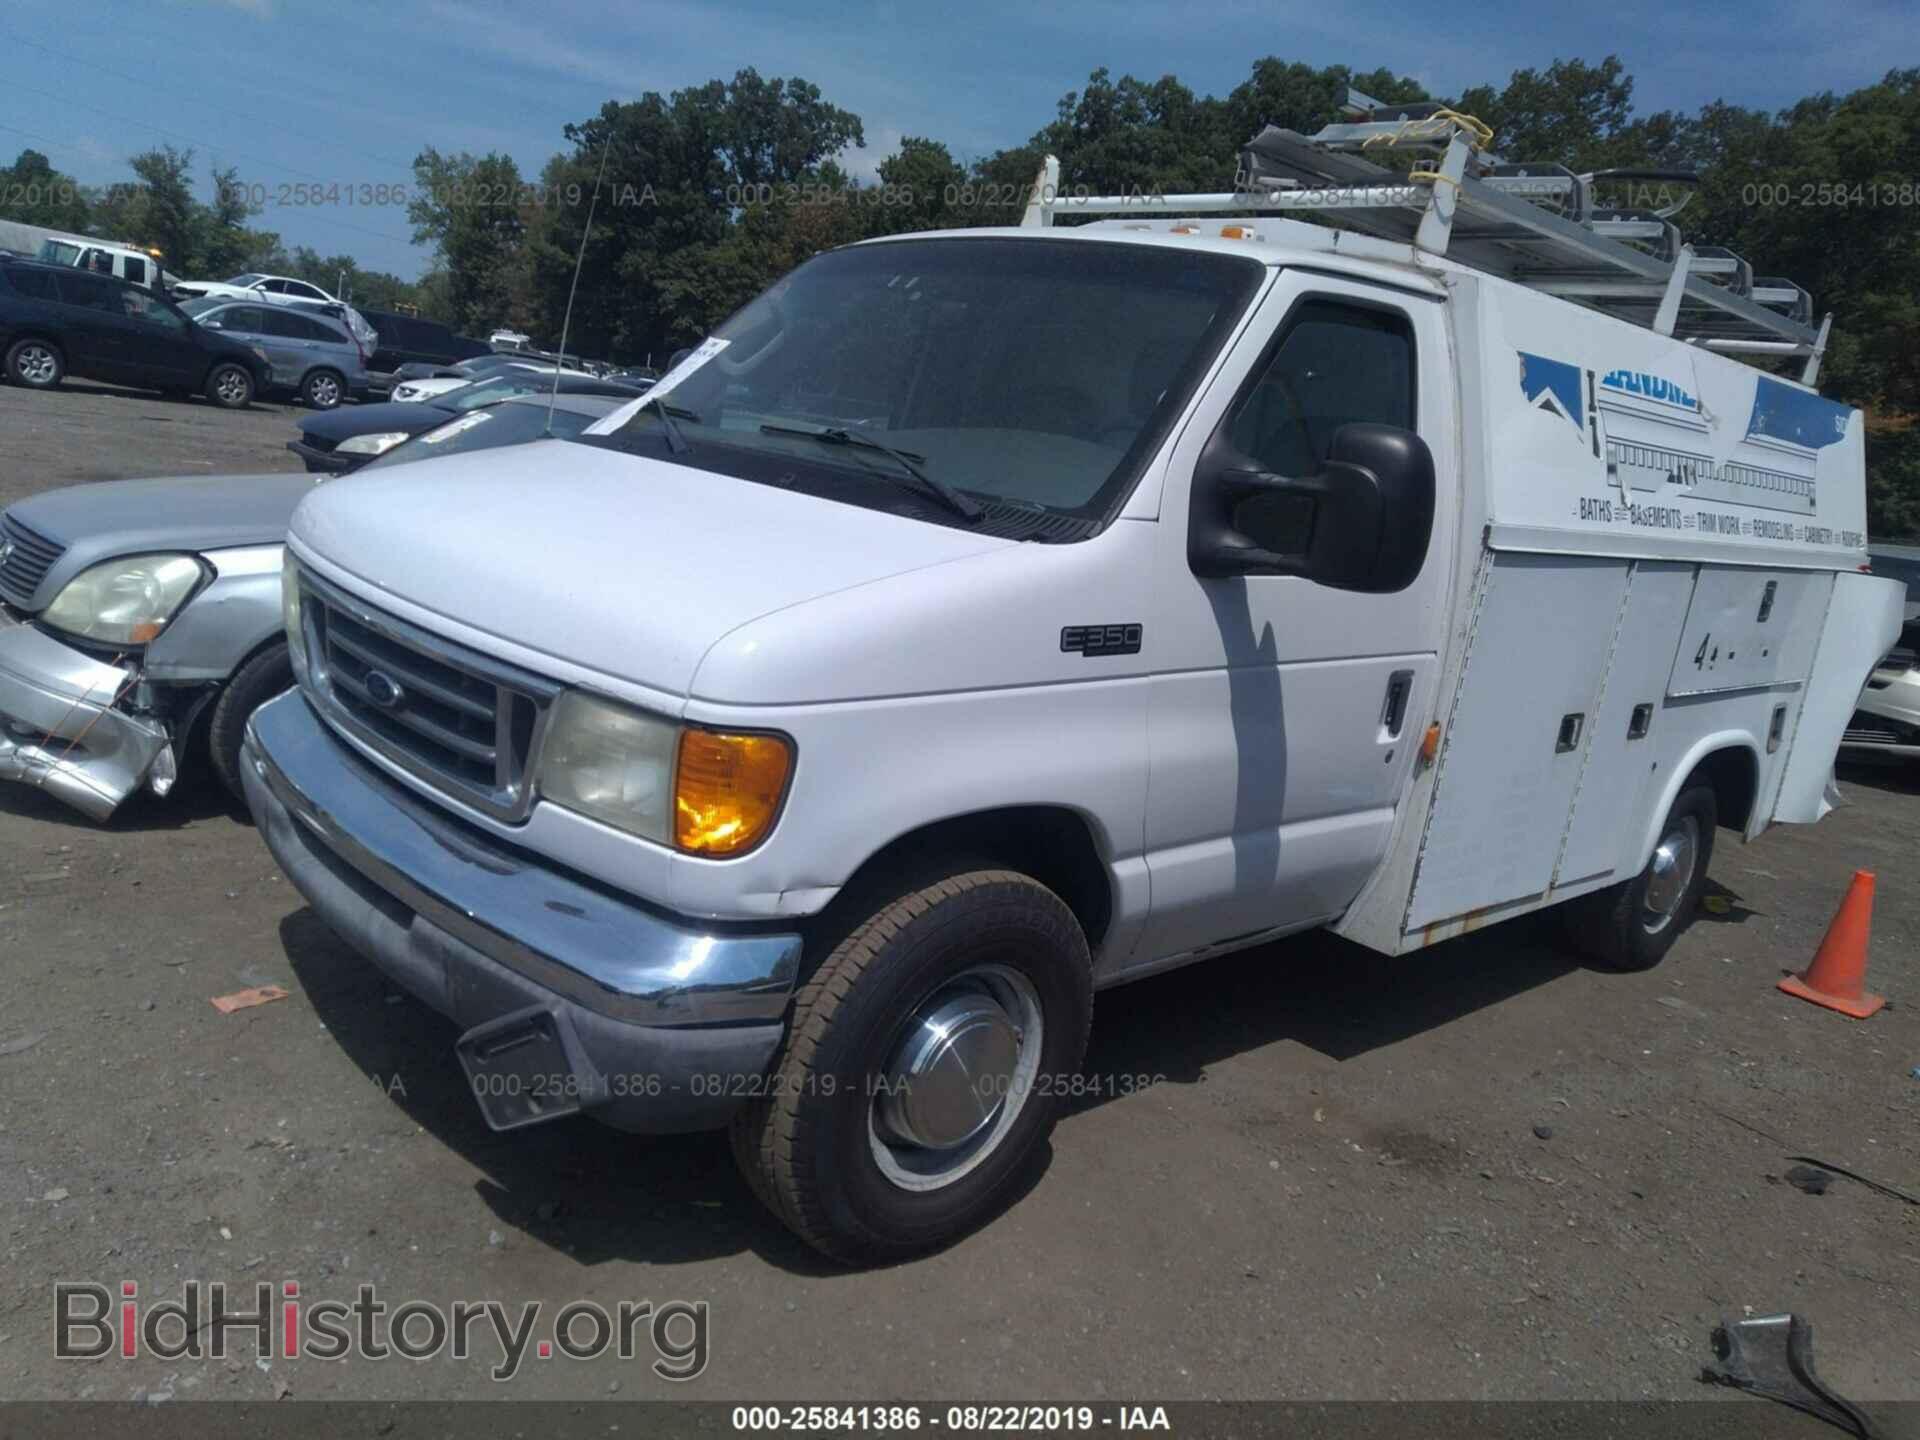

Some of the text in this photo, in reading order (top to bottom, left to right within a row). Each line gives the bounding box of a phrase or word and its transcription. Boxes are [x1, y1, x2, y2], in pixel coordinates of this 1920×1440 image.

[1580, 497, 1612, 522] BATHS
[1630, 503, 1682, 529] BASEMENTS
[1696, 511, 1717, 533] TRIM
[1718, 514, 1741, 536] WORK
[1753, 519, 1794, 541] REMODELING
